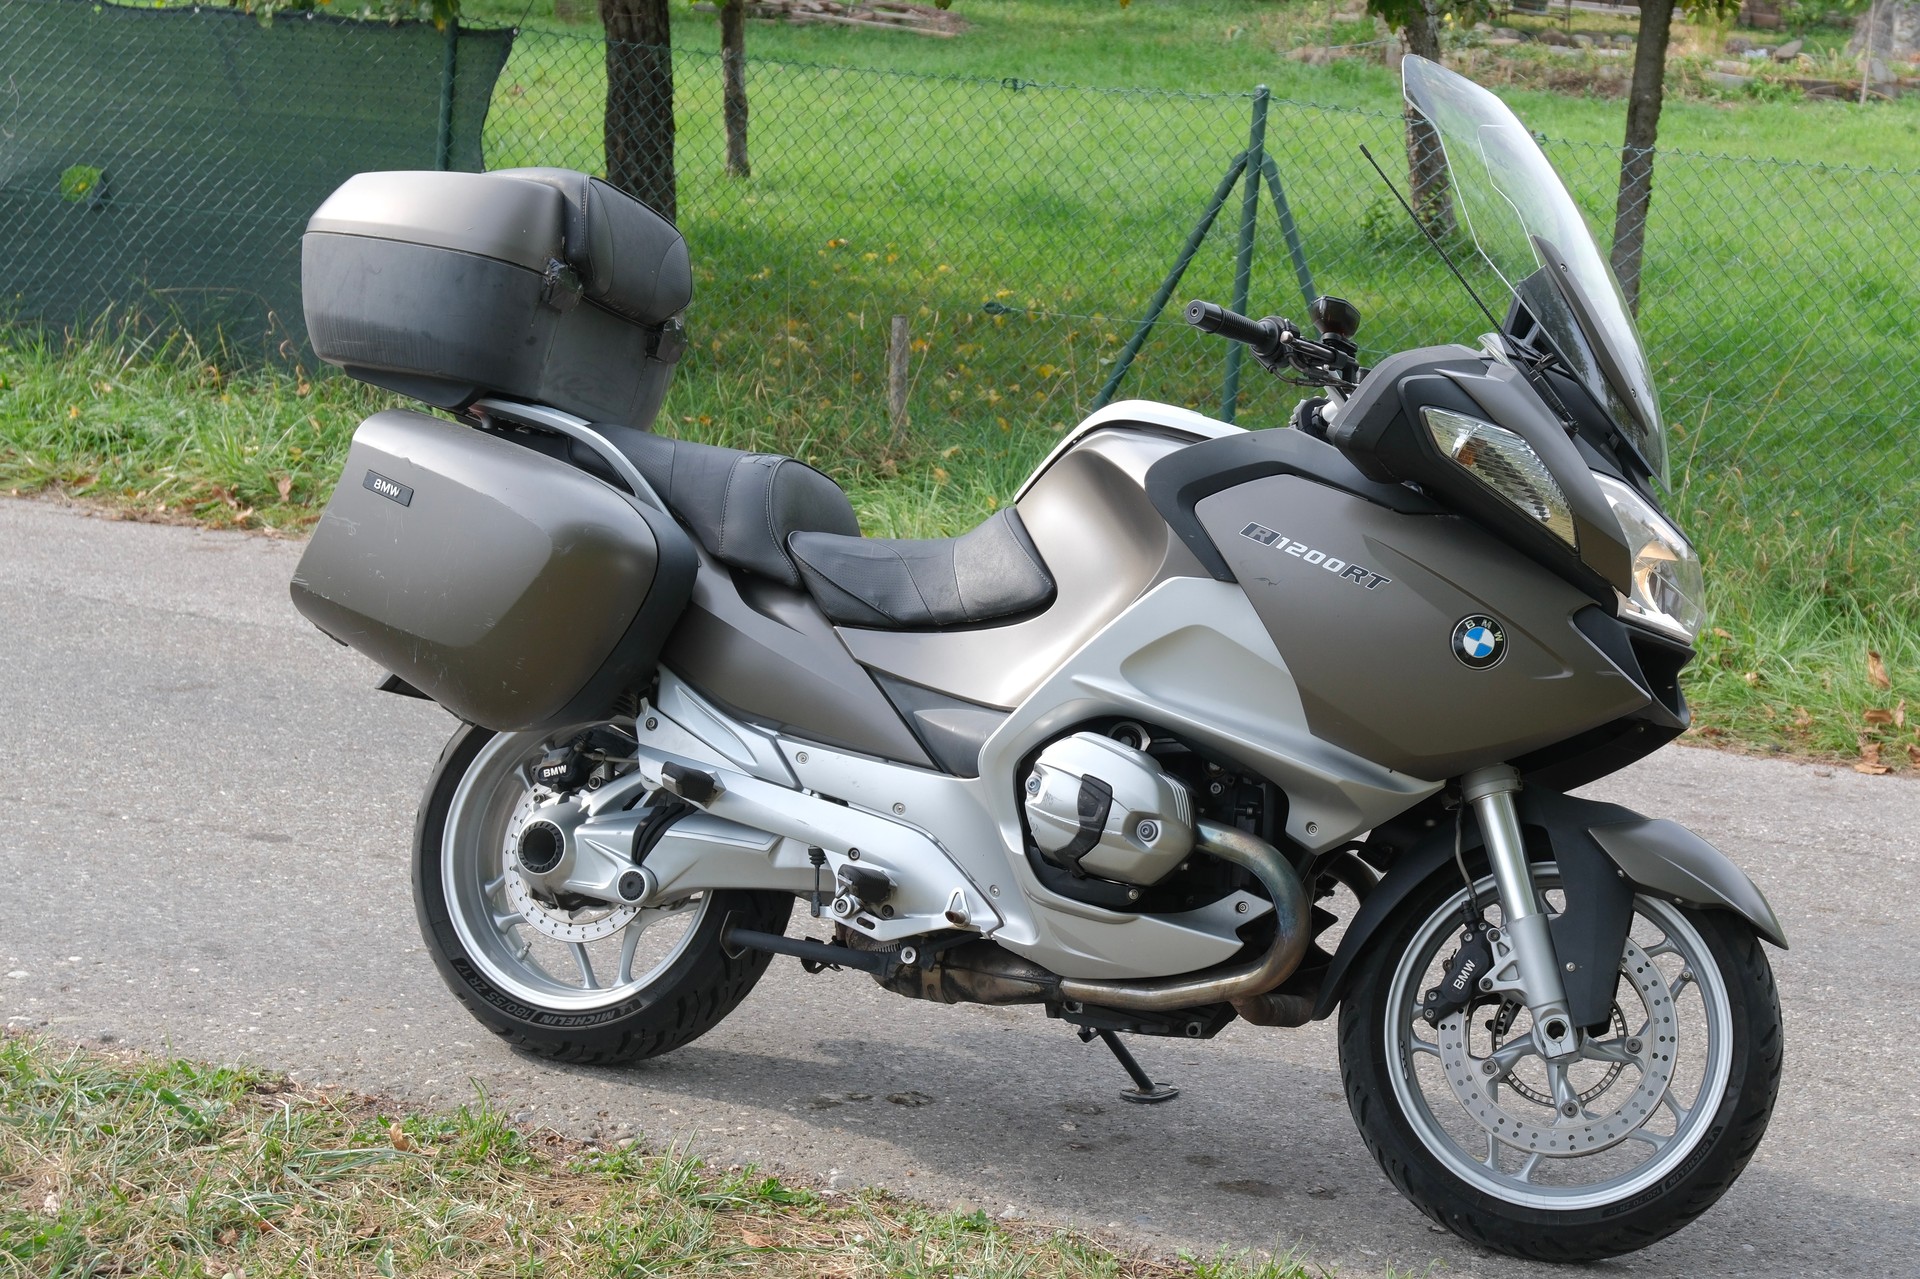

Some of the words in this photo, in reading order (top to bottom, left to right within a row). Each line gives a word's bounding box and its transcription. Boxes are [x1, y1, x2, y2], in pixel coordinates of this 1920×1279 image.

[373, 478, 401, 497] BMW
[1464, 619, 1504, 642] BMW
[543, 764, 567, 778] BMW
[455, 964, 471, 977] 17
[1453, 959, 1476, 990] BMW
[468, 976, 488, 992] ZR
[484, 991, 533, 1018] 180/55
[538, 1010, 616, 1027] MICHELIN
[1668, 1142, 1711, 1186] MICHELIN
